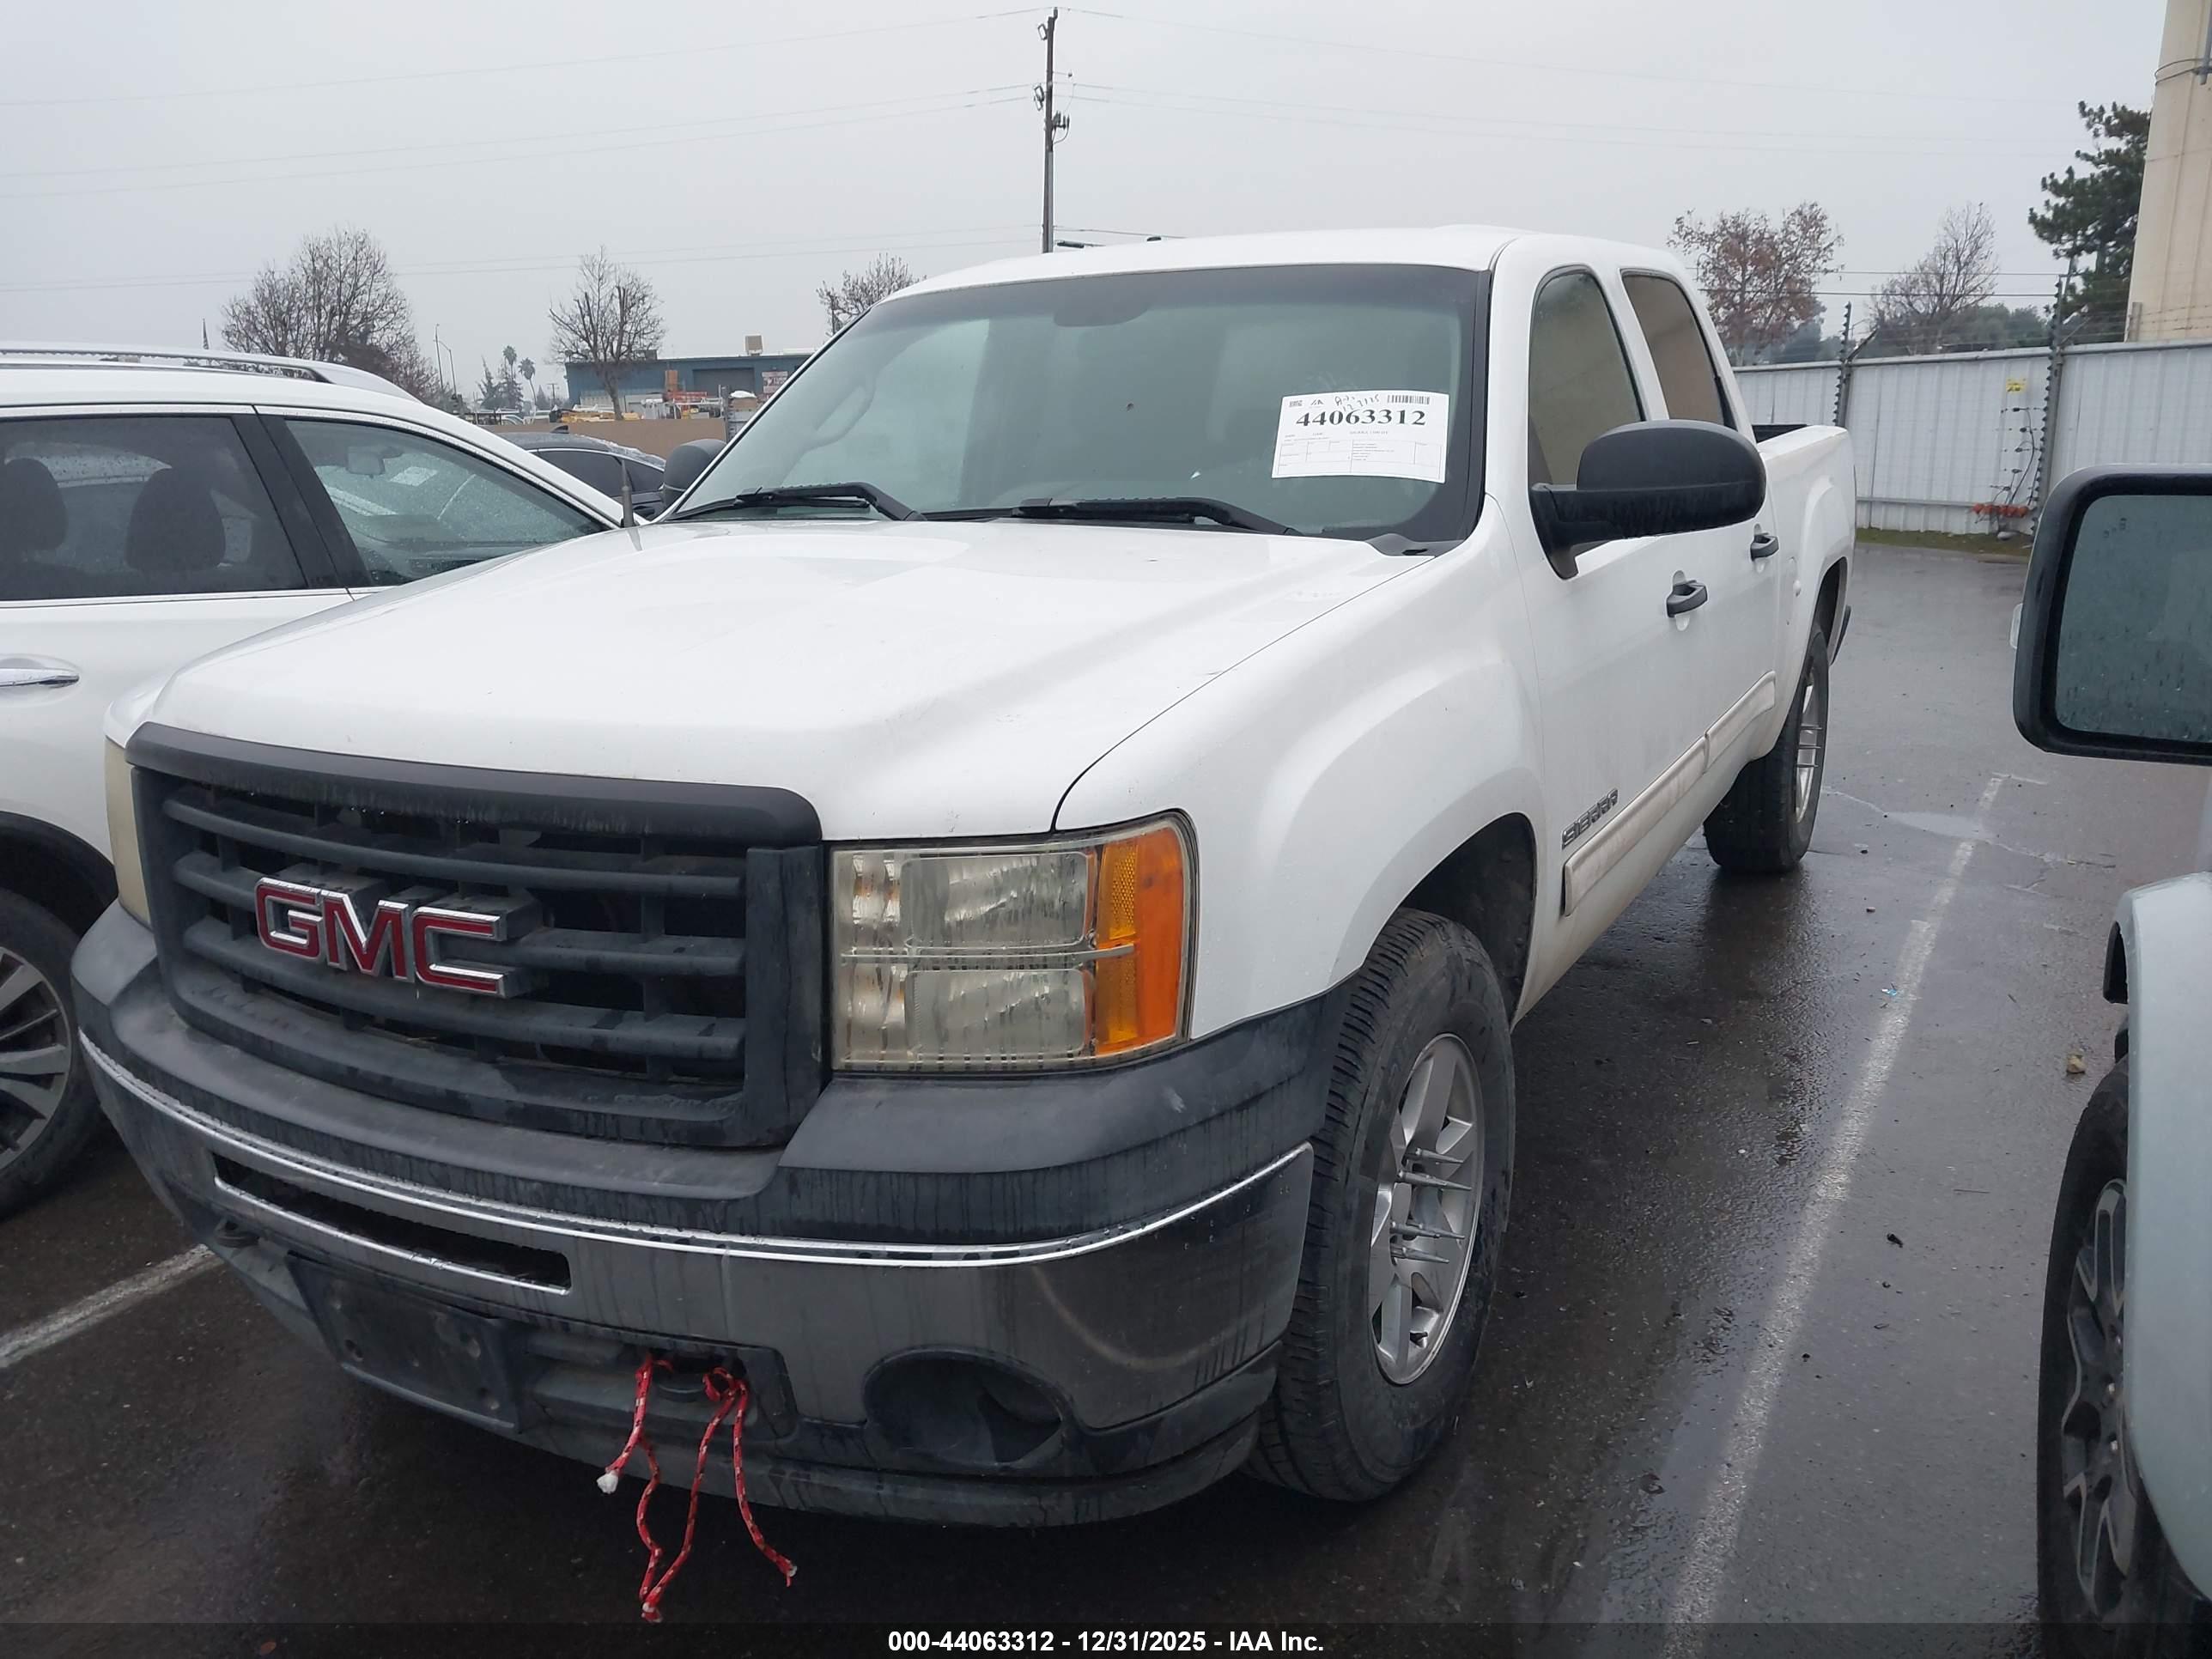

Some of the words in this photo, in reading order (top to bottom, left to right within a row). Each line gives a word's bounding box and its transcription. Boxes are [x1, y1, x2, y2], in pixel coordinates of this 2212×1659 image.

[1296, 409, 1426, 427] 44063312
[1561, 788, 1619, 850] SIERRA
[256, 877, 506, 999] GMC
